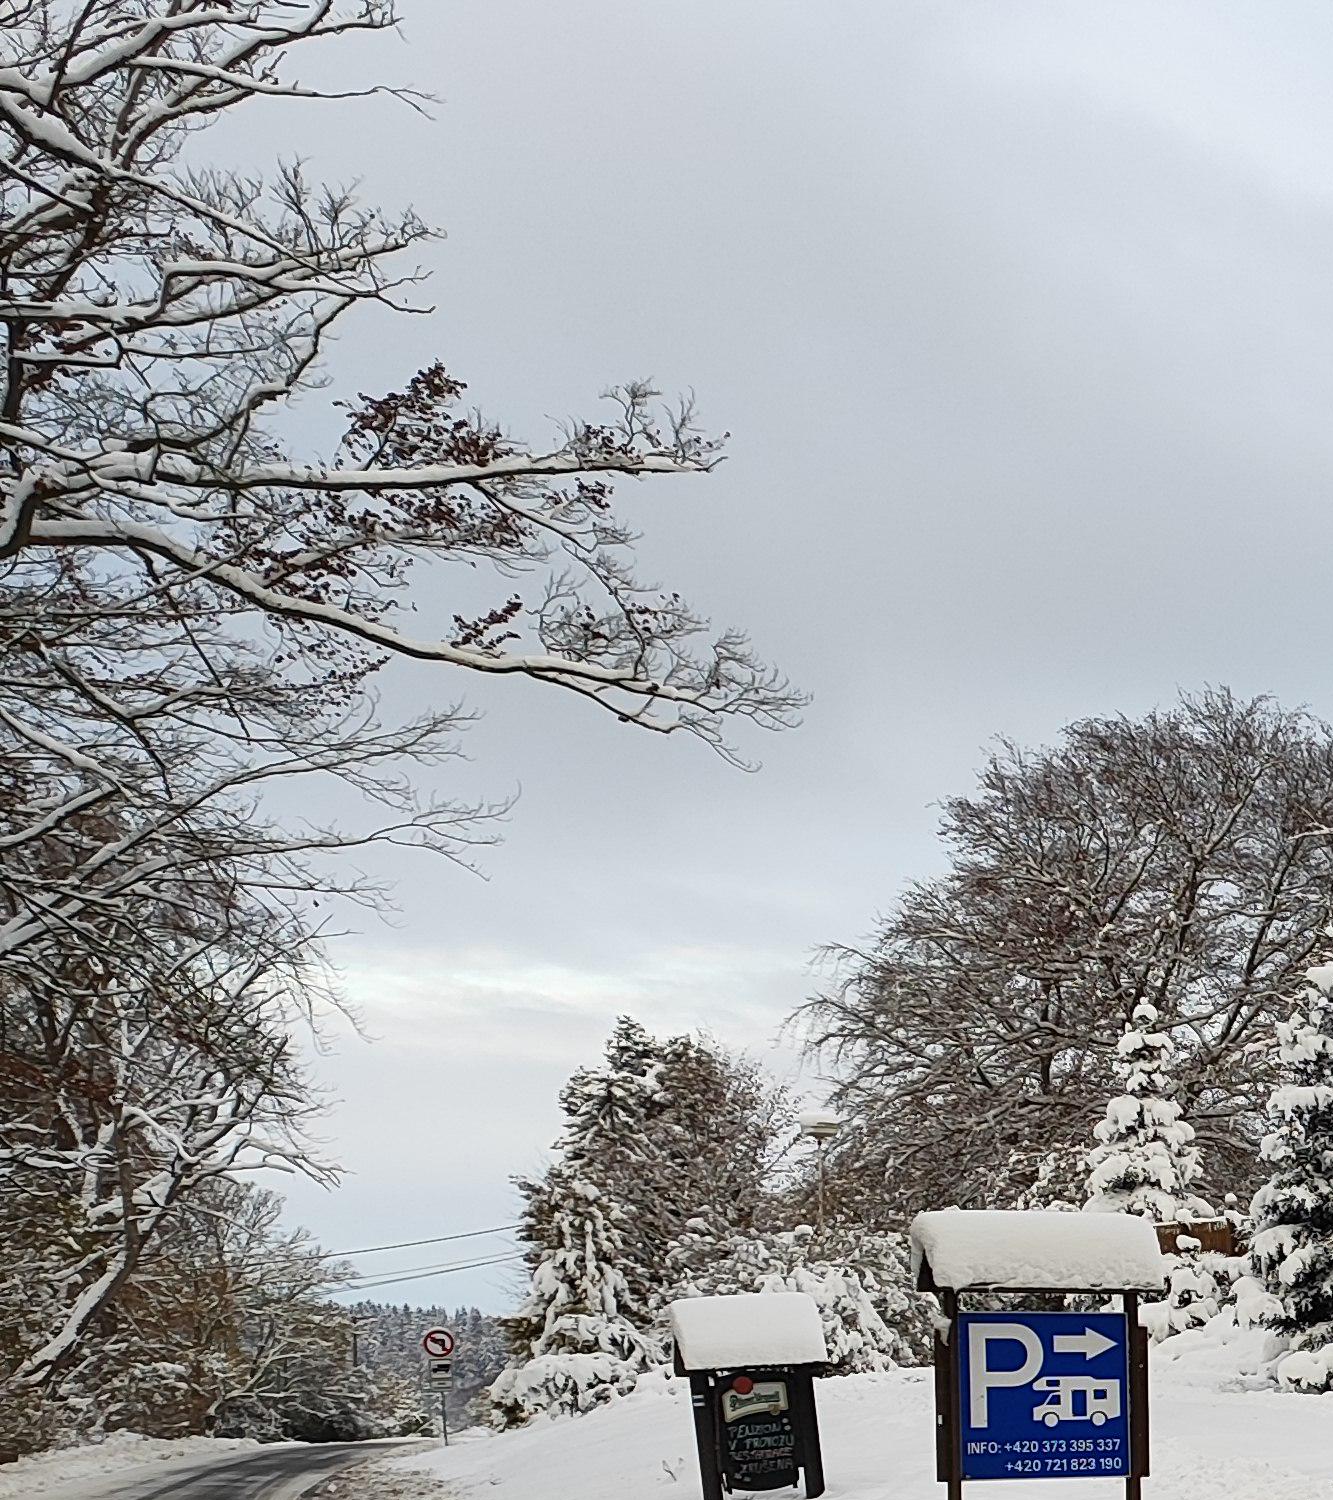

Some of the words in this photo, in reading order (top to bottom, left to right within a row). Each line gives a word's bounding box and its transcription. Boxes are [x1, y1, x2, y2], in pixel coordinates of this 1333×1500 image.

[968, 1323, 1044, 1428] P
[728, 1440, 738, 1451] V
[967, 1442, 1002, 1455] INFO:
[1004, 1440, 1039, 1453] +420
[1042, 1440, 1067, 1453] 373
[1069, 1439, 1094, 1452] 395
[1097, 1438, 1121, 1451] 337
[1005, 1459, 1041, 1472] +420
[1044, 1458, 1068, 1471] 721
[1070, 1457, 1096, 1470] 823
[1099, 1457, 1122, 1469] 190
